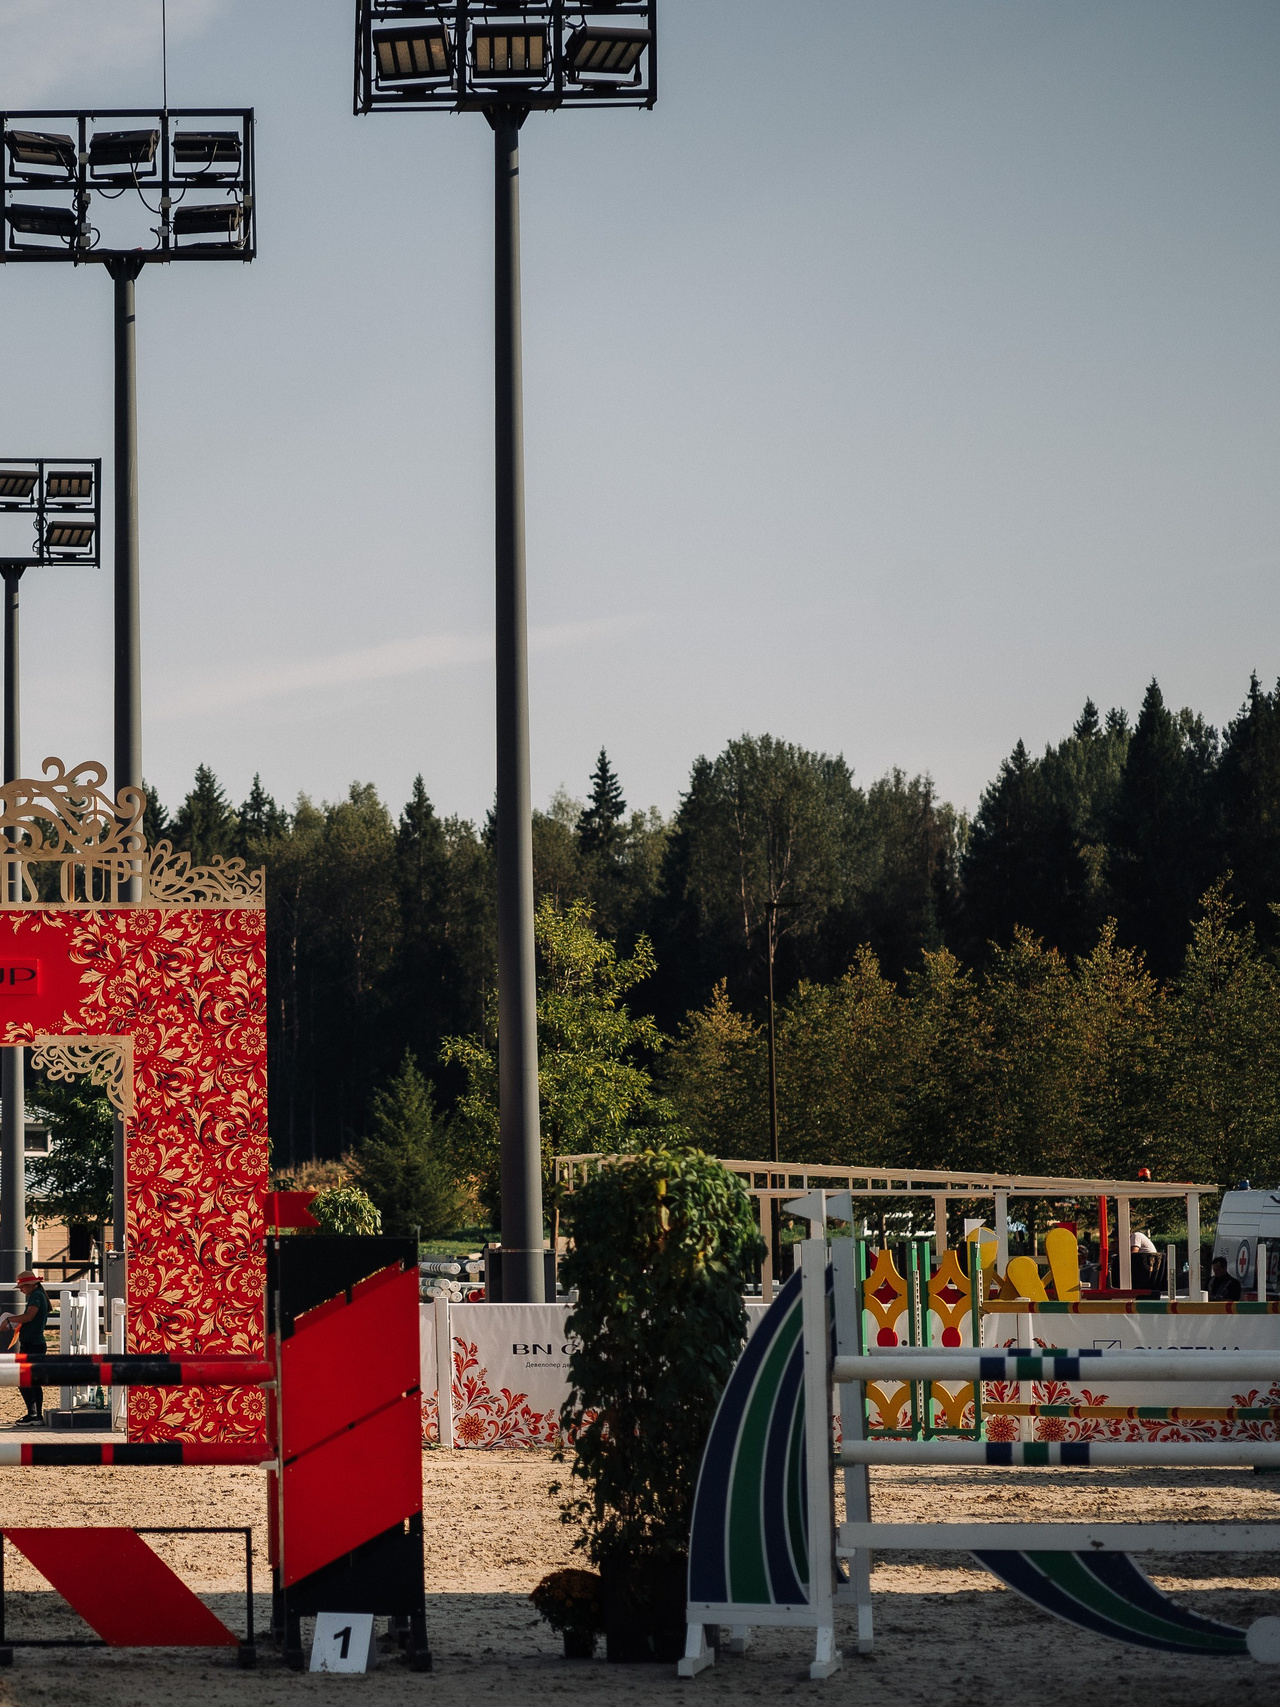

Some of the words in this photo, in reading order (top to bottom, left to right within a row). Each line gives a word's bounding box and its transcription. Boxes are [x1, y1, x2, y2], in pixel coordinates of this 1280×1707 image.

[59, 859, 132, 903] CUP
[512, 1343, 552, 1355] BN
[525, 1361, 561, 1369] Девелопер
[333, 1626, 352, 1659] 1
